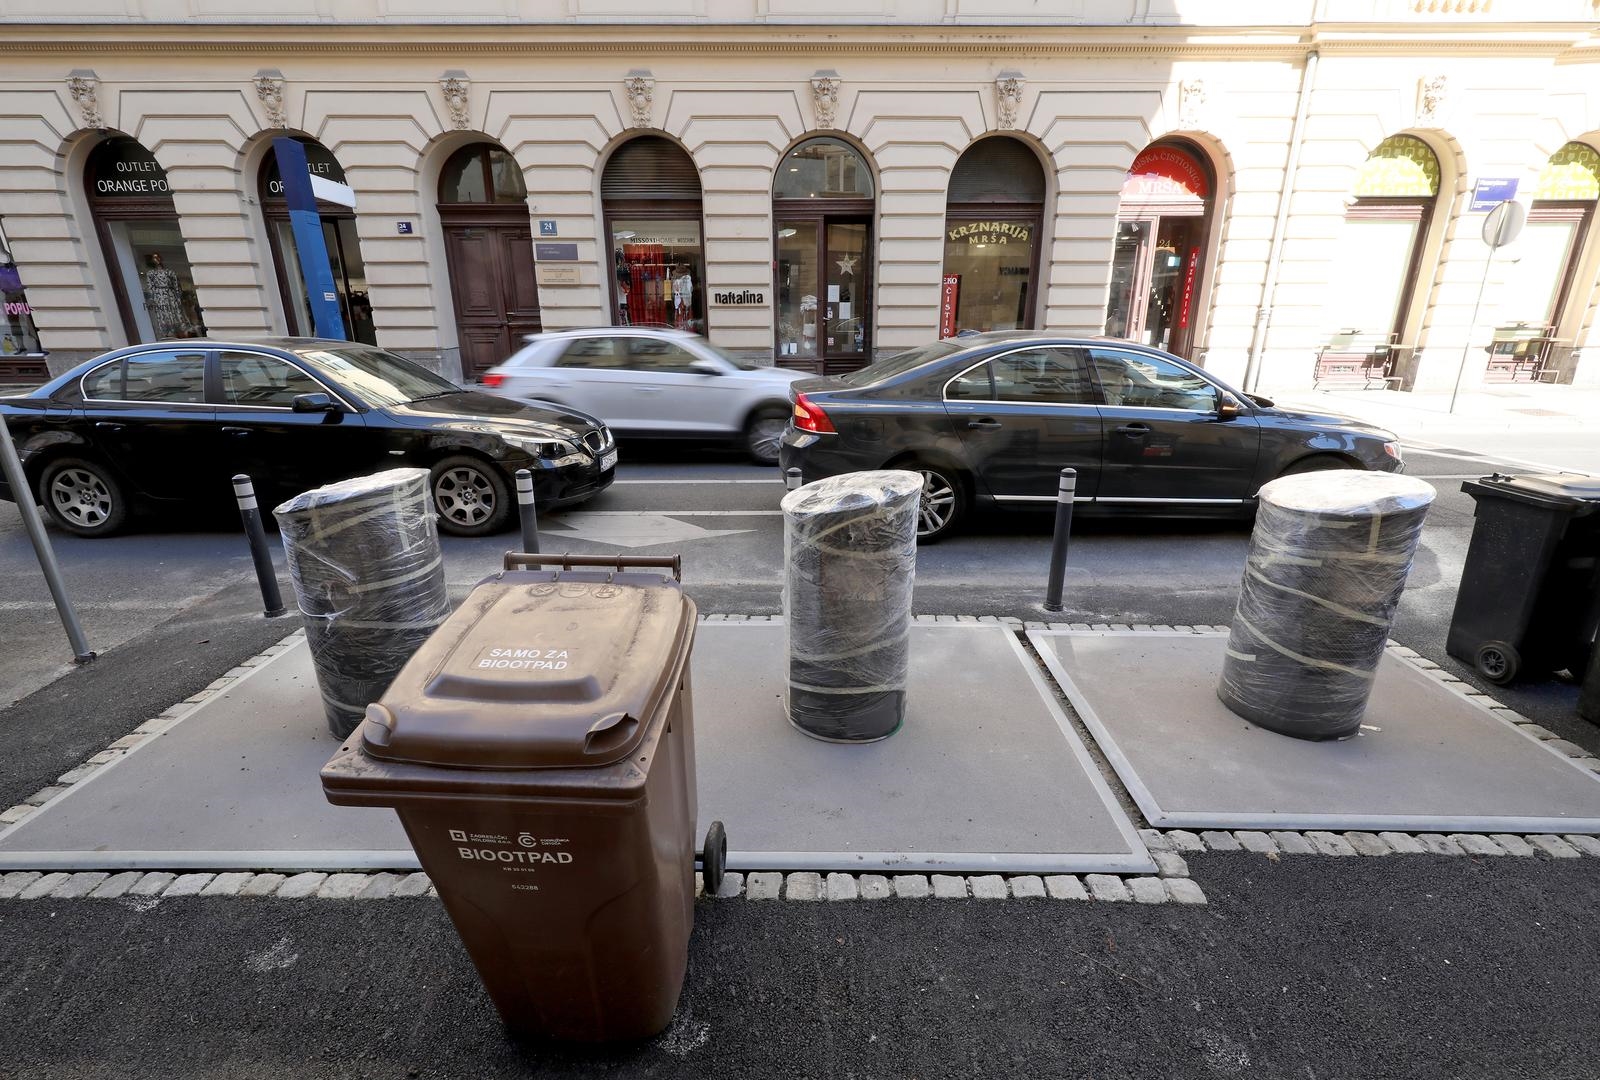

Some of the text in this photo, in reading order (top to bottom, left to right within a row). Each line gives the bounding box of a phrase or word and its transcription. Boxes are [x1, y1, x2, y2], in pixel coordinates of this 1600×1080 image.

[116, 161, 157, 172] OUTLET
[307, 162, 330, 173] TLET
[97, 180, 149, 192] ORANGE
[543, 222, 553, 231] 24
[948, 222, 1029, 241] KRZNARIJA
[968, 232, 1007, 245] MRŠA
[714, 289, 764, 304] naftalina
[489, 647, 569, 659] SAMO ZA
[478, 658, 568, 670] BIOOTPAD
[457, 847, 573, 864] BIOOTPAD
